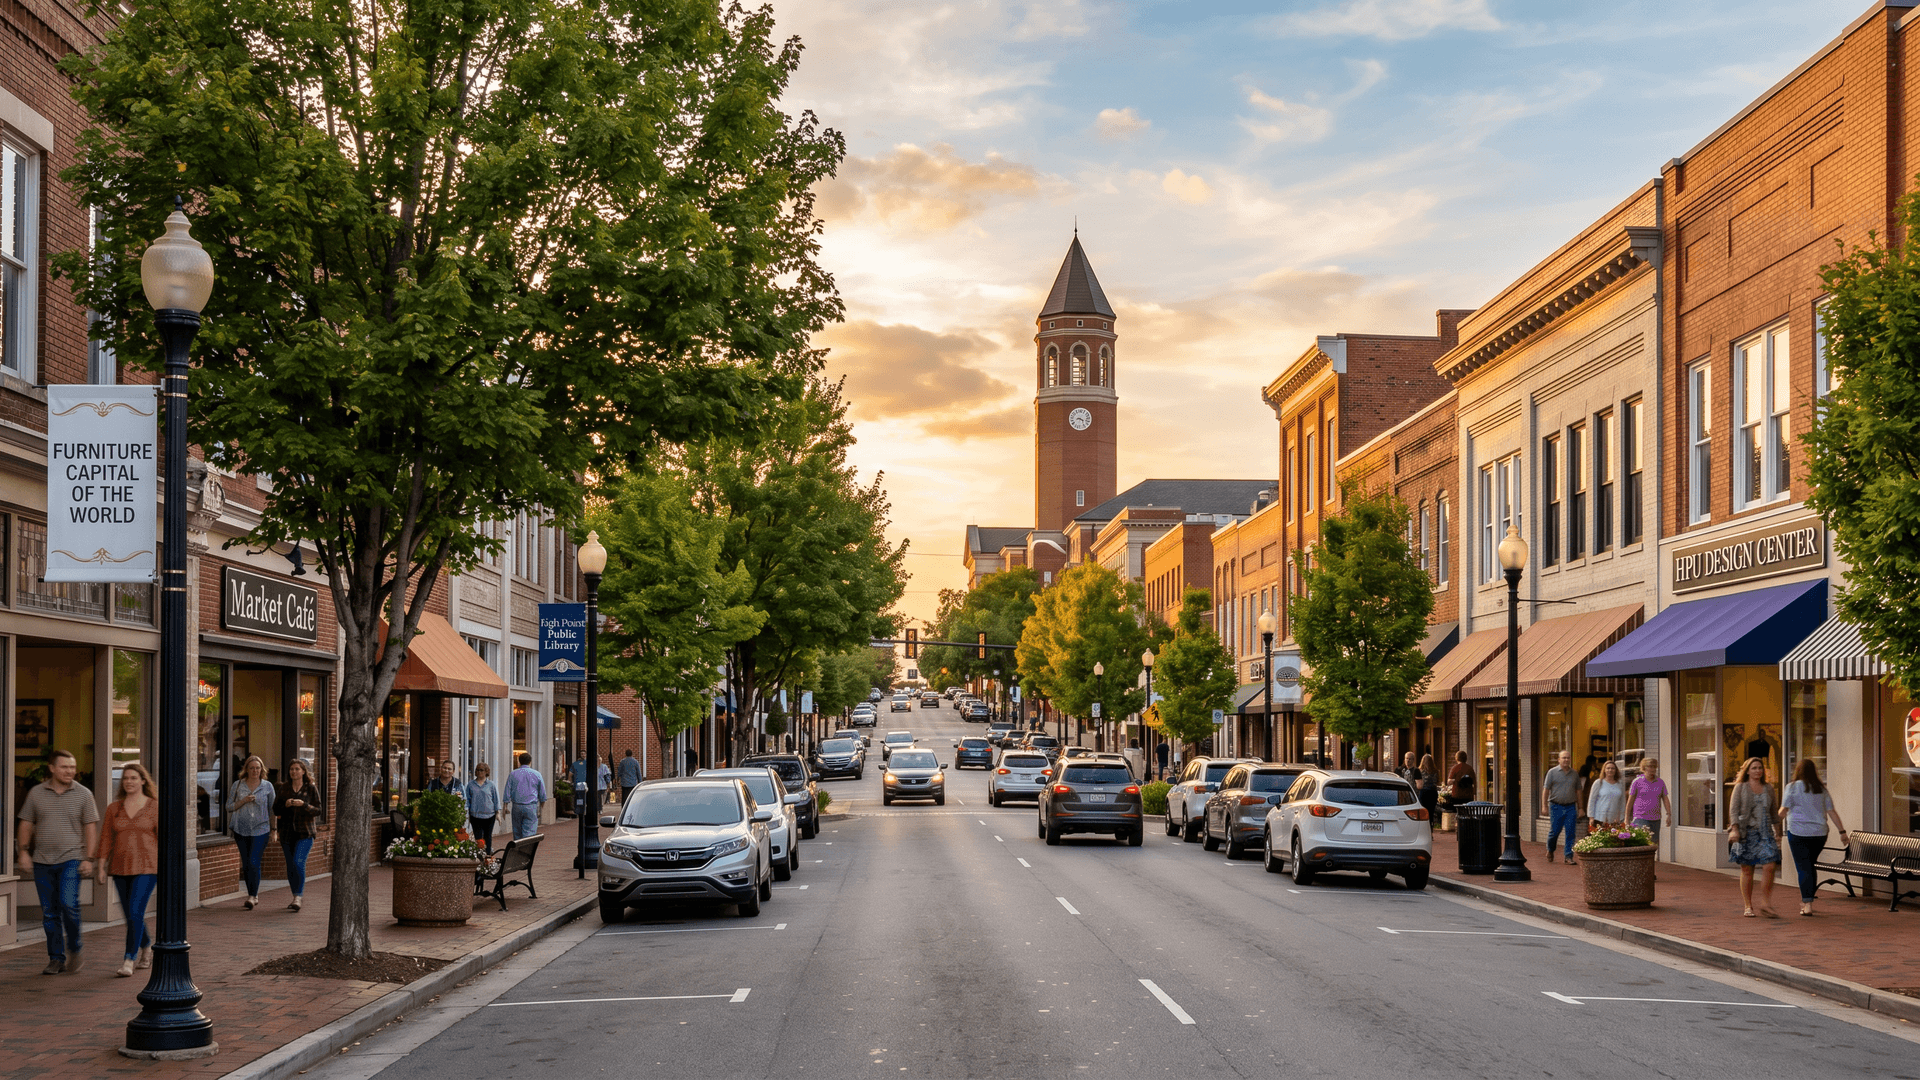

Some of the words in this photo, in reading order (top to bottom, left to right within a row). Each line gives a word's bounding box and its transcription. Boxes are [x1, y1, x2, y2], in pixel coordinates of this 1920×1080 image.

[53, 443, 153, 460] FURNITURE
[66, 464, 140, 481] CAPITAL
[71, 486, 95, 502] OF
[100, 486, 134, 502] THE
[69, 507, 135, 524] WORLD
[1675, 552, 1703, 582] HPU
[1704, 540, 1754, 577] DESIGN
[1756, 526, 1818, 565] CENTER
[230, 578, 283, 626] Market
[286, 593, 315, 632] Café
[547, 628, 577, 639] Public
[543, 640, 580, 653] Library
